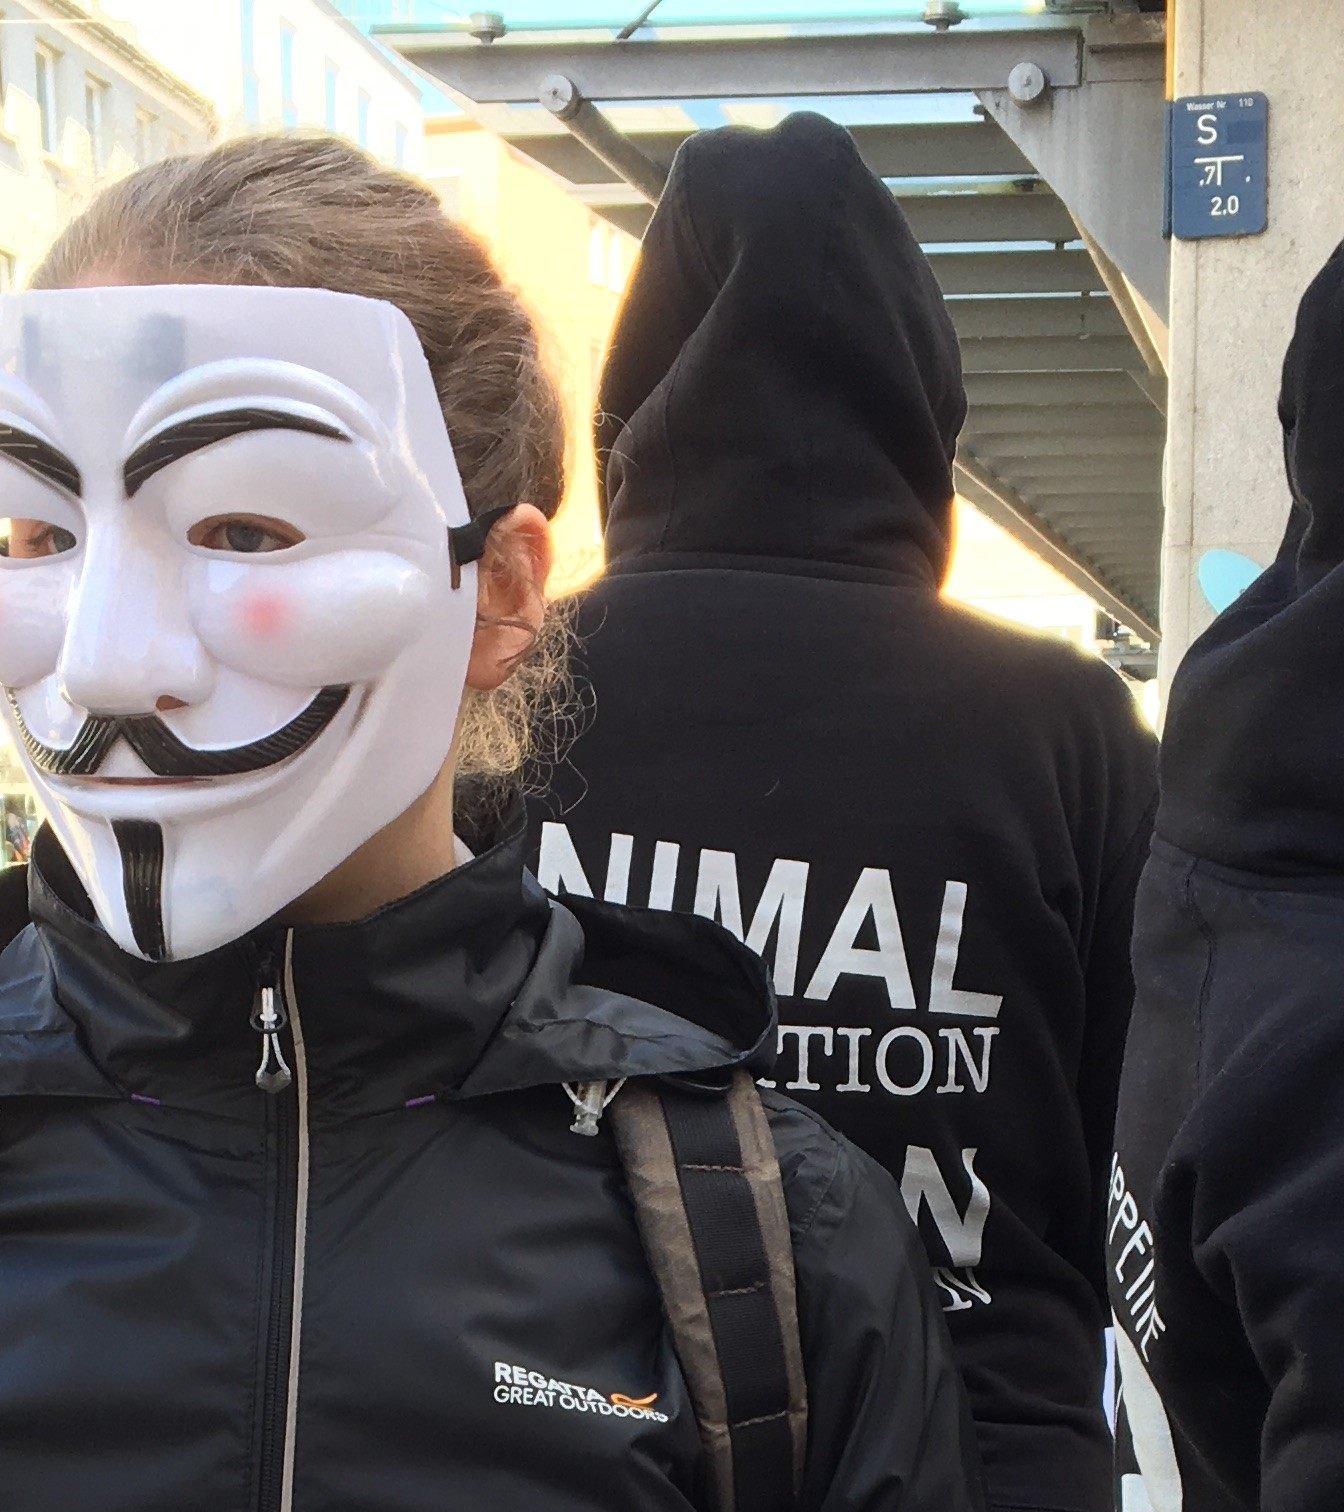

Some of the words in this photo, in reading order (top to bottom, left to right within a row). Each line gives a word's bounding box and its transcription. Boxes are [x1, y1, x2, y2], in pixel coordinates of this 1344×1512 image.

[1197, 113, 1218, 145] S
[1210, 195, 1239, 216] 2.0
[494, 1361, 606, 1403] REGATTA
[493, 1385, 557, 1407] GREAT
[559, 1394, 669, 1423] OUTDOORS
